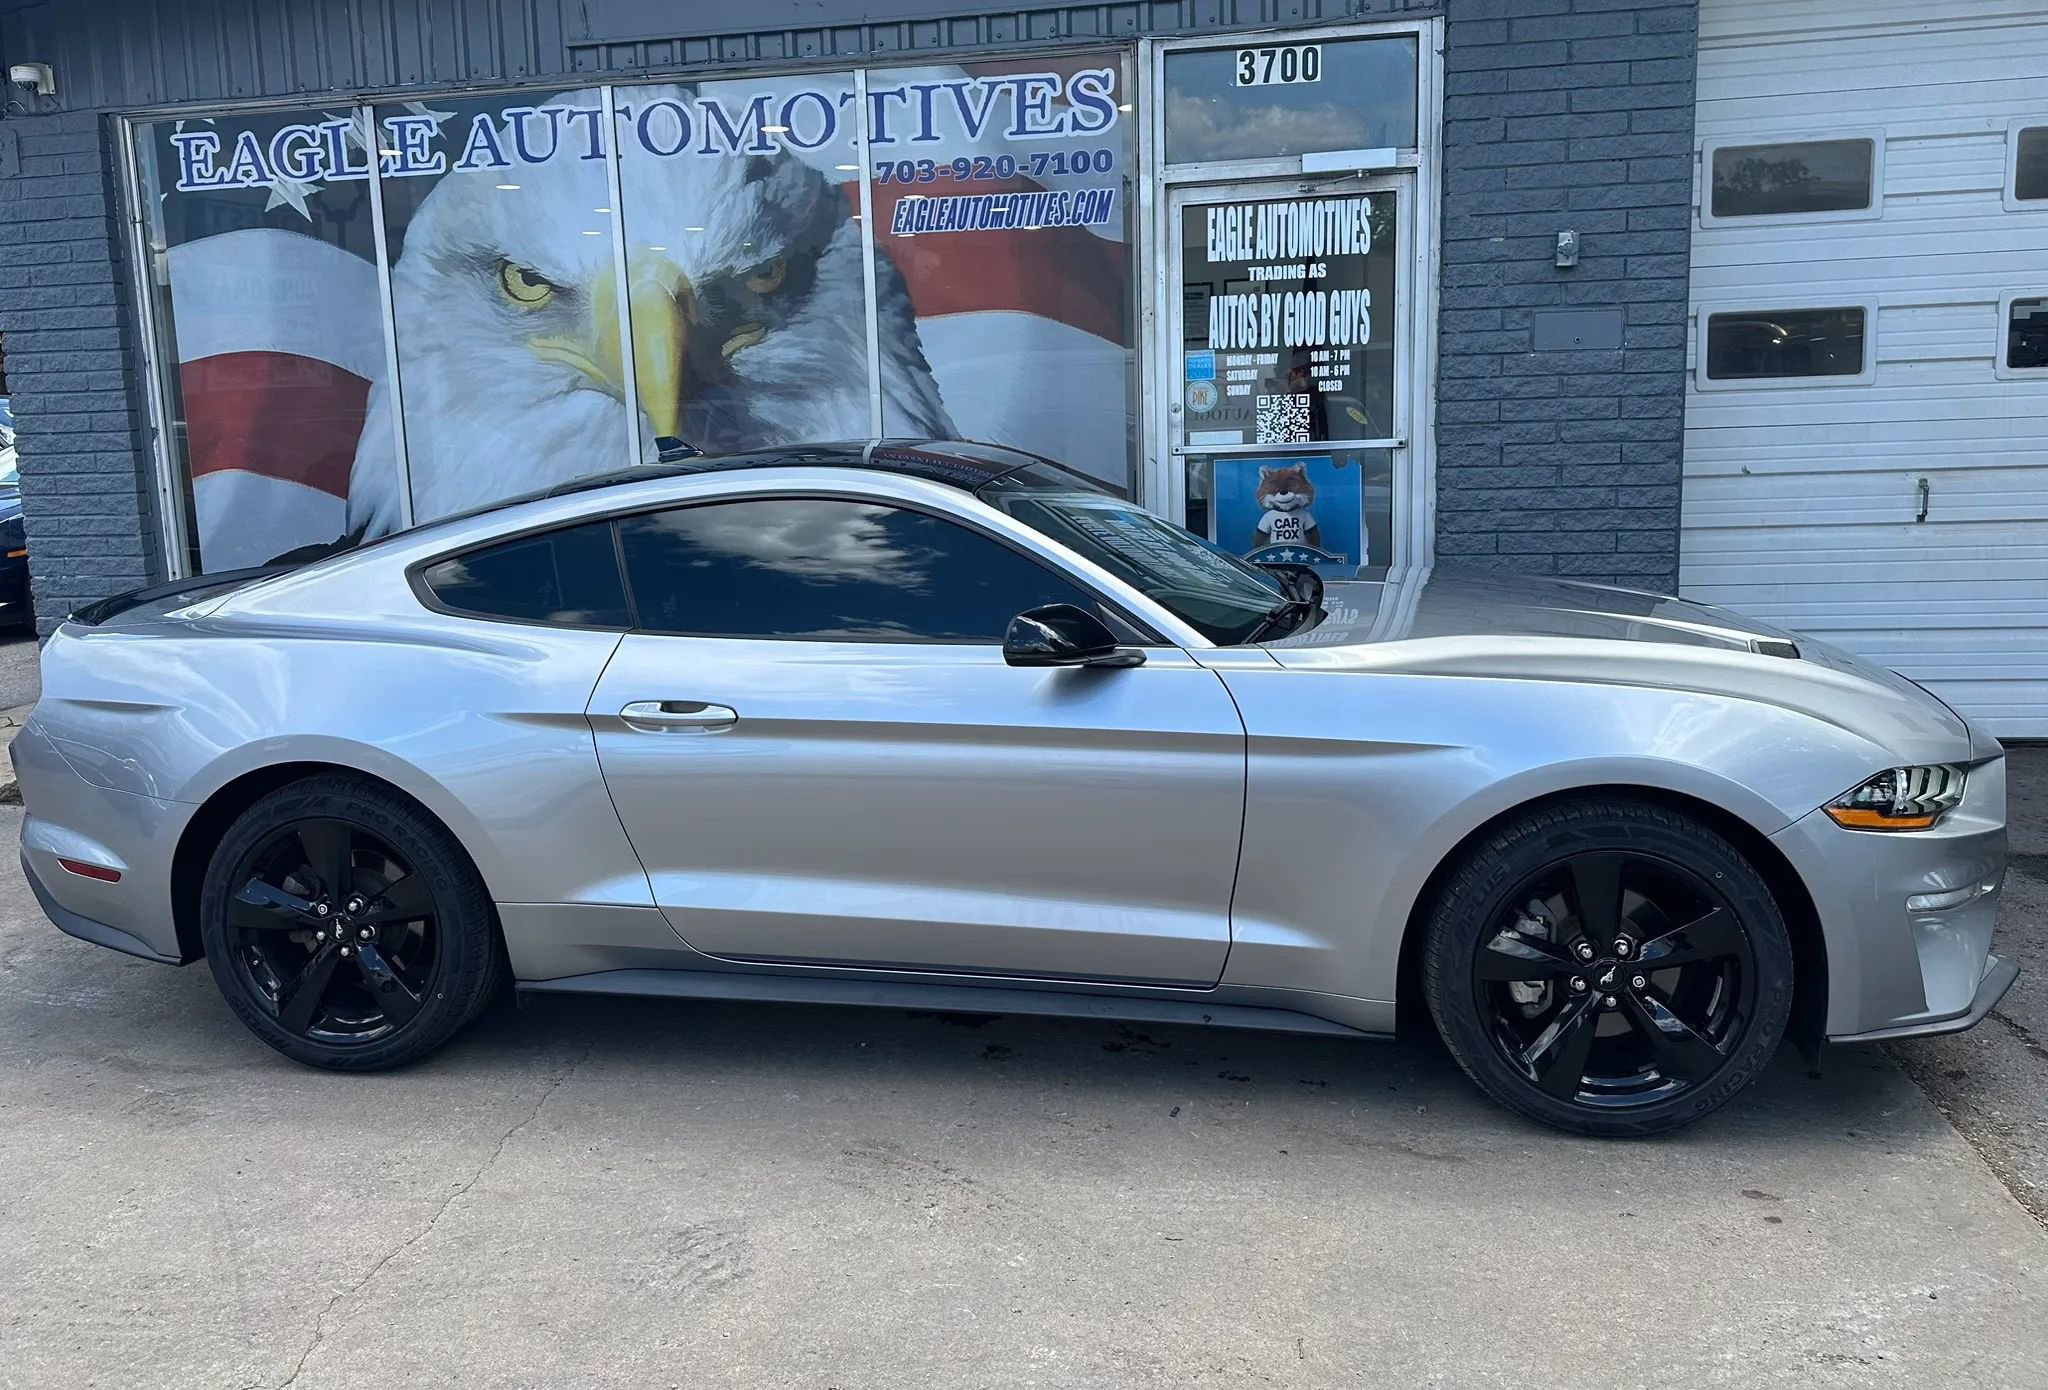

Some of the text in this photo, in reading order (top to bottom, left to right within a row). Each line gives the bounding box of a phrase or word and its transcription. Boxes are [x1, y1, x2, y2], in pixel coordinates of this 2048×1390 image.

[1239, 47, 1319, 85] 3700
[171, 68, 1118, 192] EAGLE AUTOMOTIVES
[876, 149, 1114, 185] 703-920-7100
[891, 188, 1116, 234] EAGLEAUTOMOTIVES.COM
[1207, 197, 1371, 262] EAGLE AUTOMOTIVES
[1248, 262, 1327, 281] TRADING AS
[1208, 288, 1371, 349] AUTOS BY GOOD GUYS
[1226, 355, 1252, 367] MONDAY
[1256, 353, 1278, 365] FRIDAY
[1310, 351, 1317, 362] 10
[1319, 350, 1329, 362] AM
[1334, 350, 1338, 360] 7
[1340, 349, 1350, 360] PM
[1226, 369, 1258, 381] SATURDAY
[1310, 366, 1317, 377] 10
[1319, 366, 1329, 377] AM
[1334, 365, 1338, 376] 6
[1340, 365, 1350, 376] PM
[1226, 384, 1251, 396] SUNDAY
[1318, 380, 1342, 392] CLOSED
[1274, 517, 1300, 530] CAR
[1276, 529, 1300, 540] FOX
